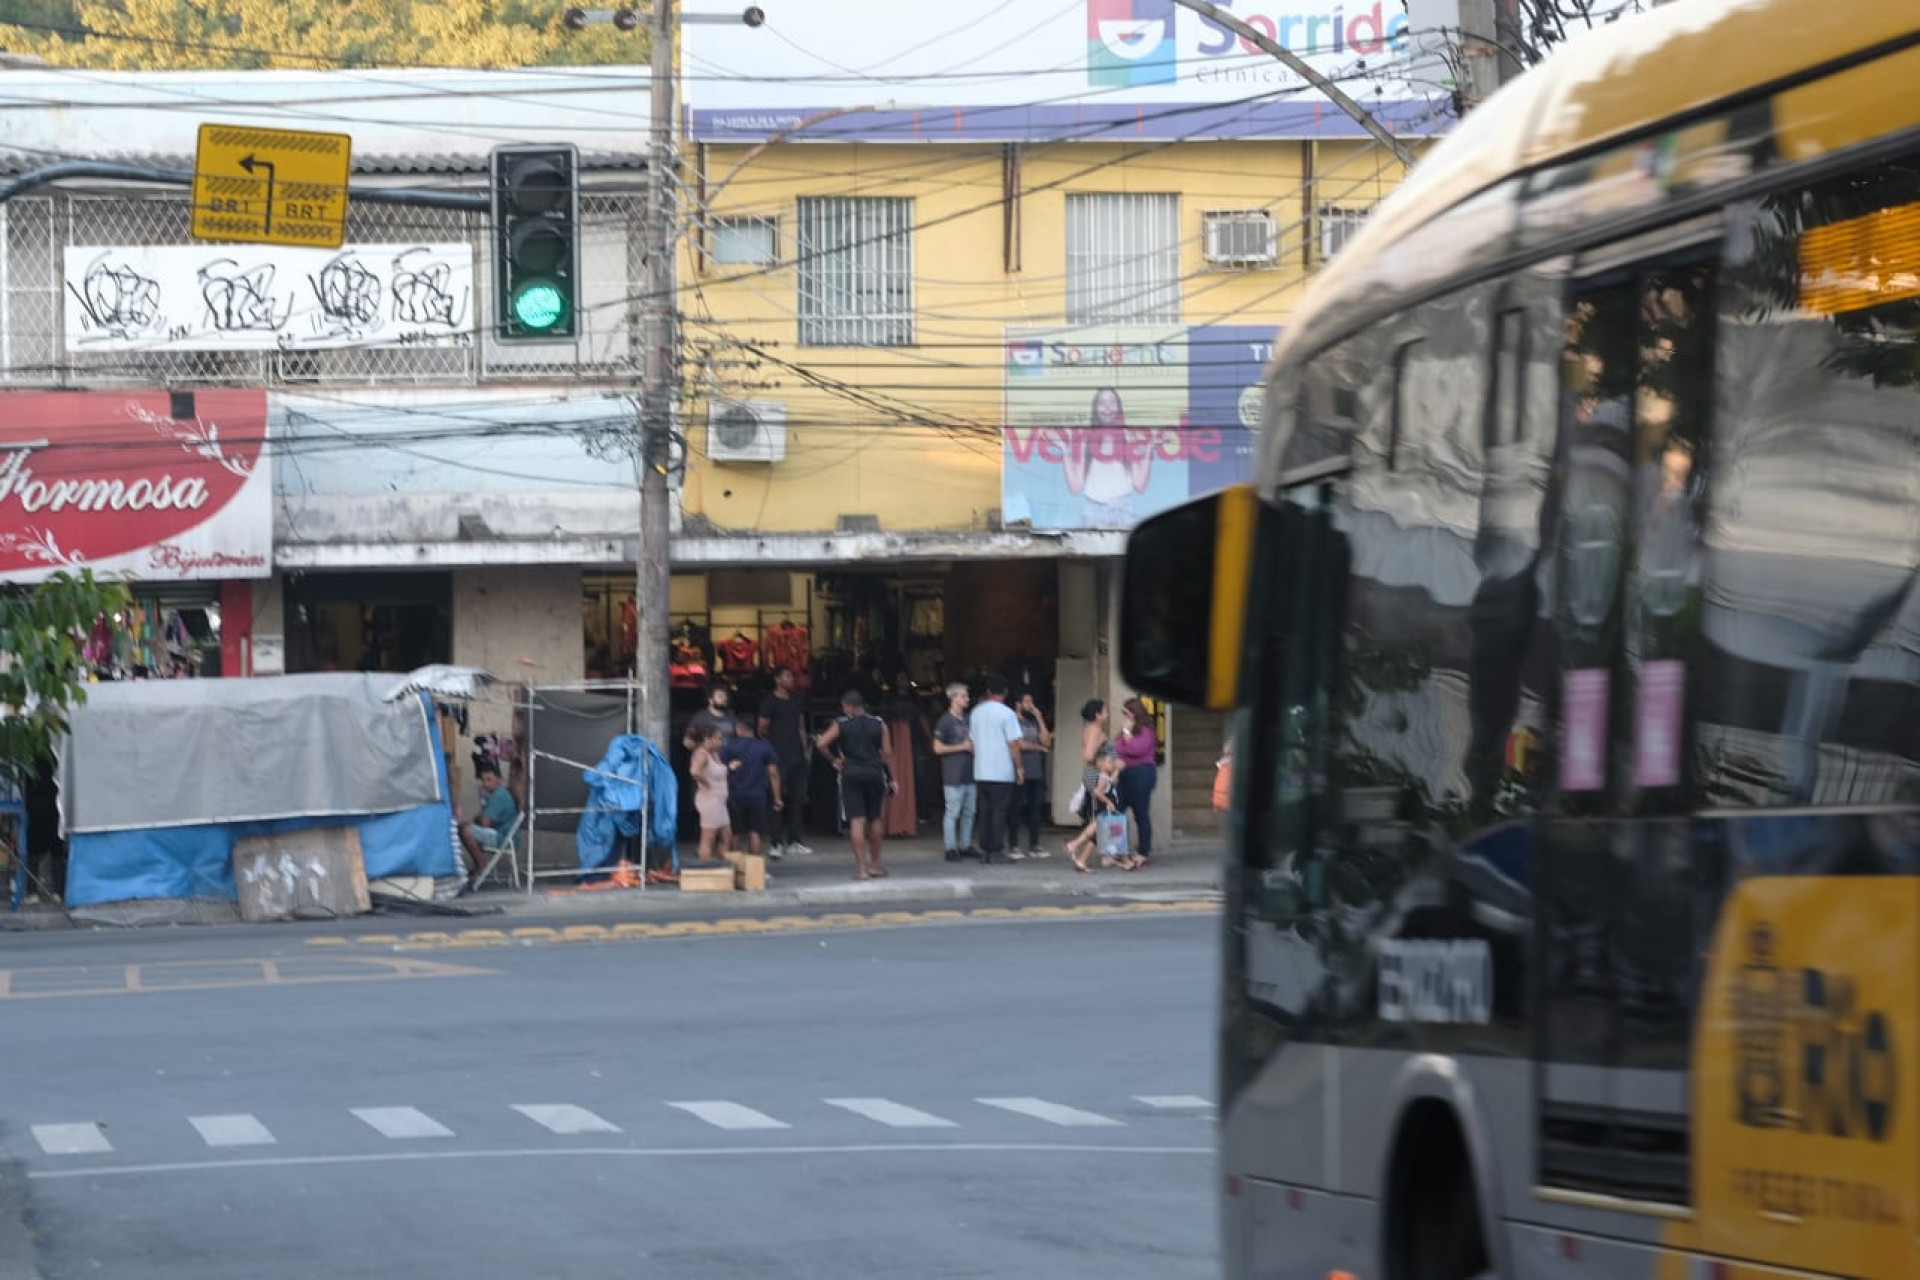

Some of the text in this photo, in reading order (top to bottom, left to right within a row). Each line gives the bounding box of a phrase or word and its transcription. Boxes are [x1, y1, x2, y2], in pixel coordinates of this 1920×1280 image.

[211, 197, 249, 214] BRT
[285, 202, 327, 220] BRT
[0, 437, 208, 513] Formosa
